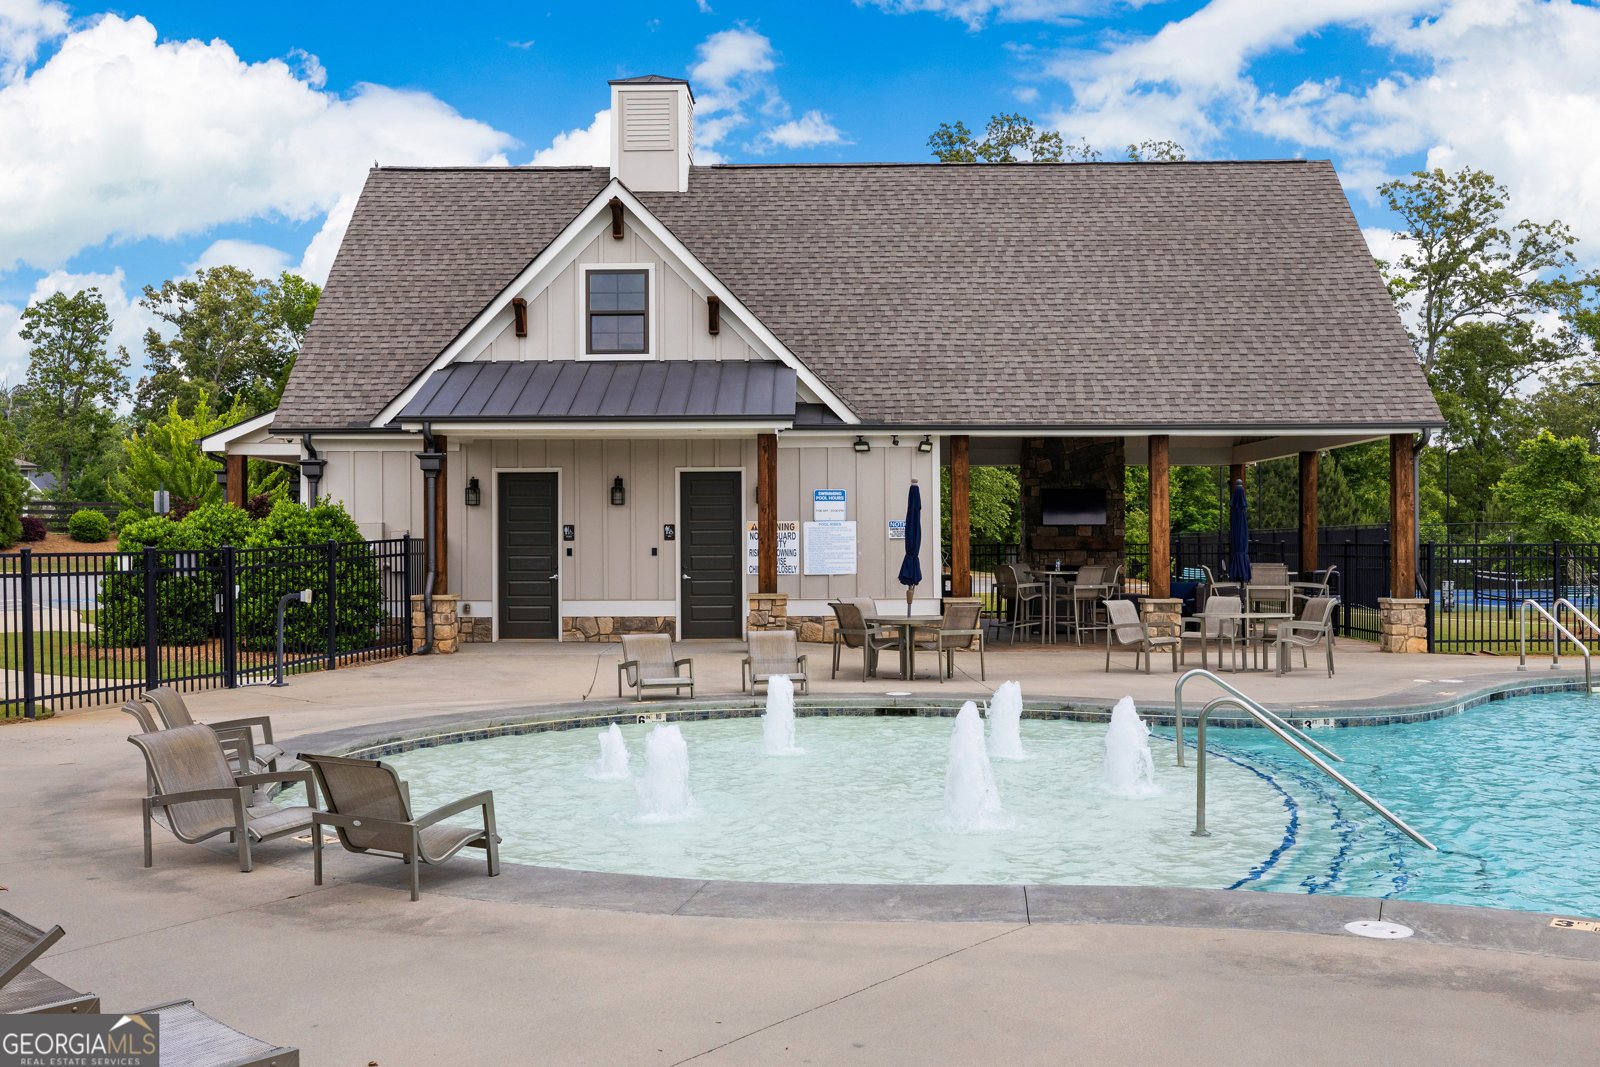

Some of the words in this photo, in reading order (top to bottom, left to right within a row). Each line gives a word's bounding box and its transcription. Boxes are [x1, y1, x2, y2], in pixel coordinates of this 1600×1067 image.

[777, 523, 795, 531] NING
[749, 549, 758, 557] RIS
[777, 549, 797, 557] OWNING
[638, 715, 646, 723] 6
[1305, 720, 1312, 729] 3
